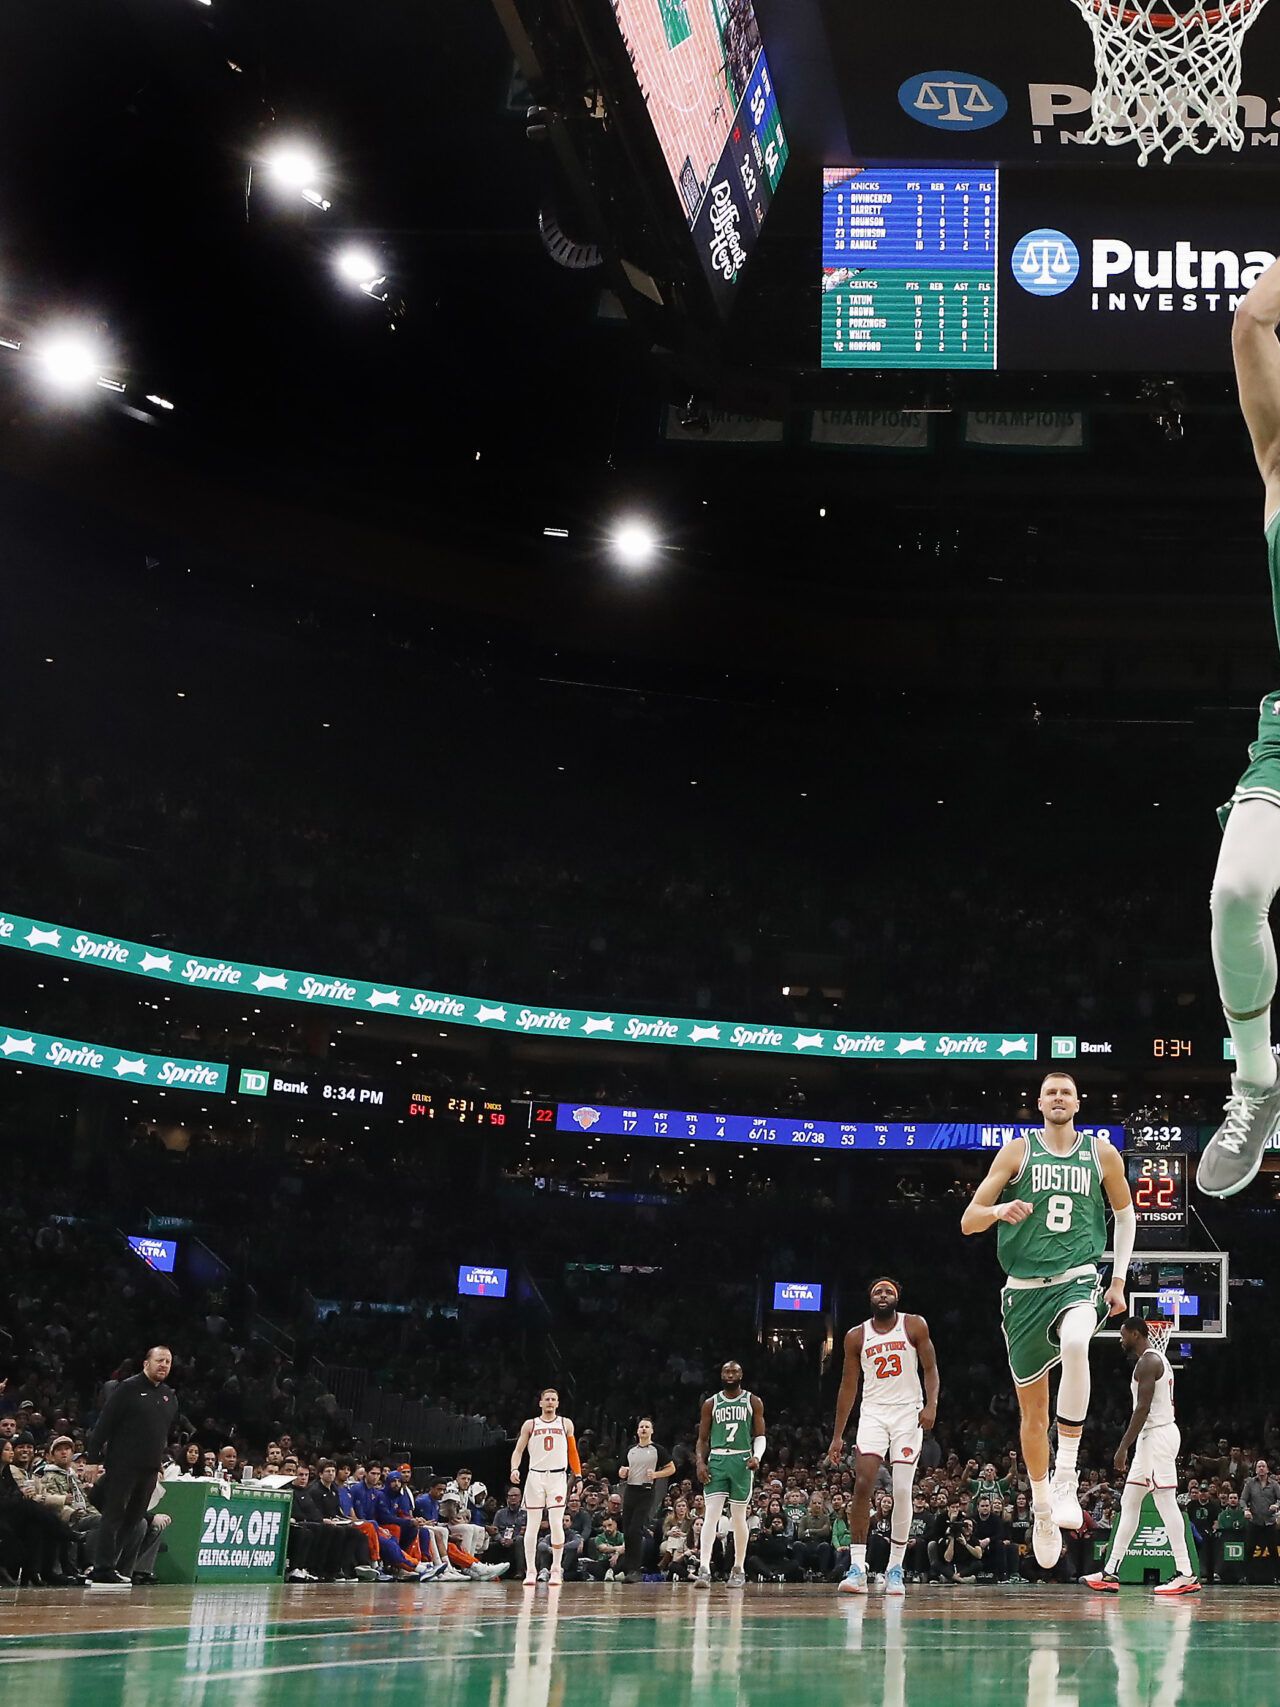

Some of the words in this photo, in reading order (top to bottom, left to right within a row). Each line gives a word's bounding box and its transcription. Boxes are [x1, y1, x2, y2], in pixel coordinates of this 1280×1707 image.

[849, 295, 872, 304] TATUM
[71, 933, 130, 964] Sprite
[181, 958, 242, 987] Sprite
[298, 976, 357, 1002] Sprite
[410, 993, 466, 1018] Sprite
[516, 1008, 571, 1033] Sprite
[623, 1017, 679, 1041] Sprite
[730, 1026, 782, 1048] Sprite
[833, 1034, 886, 1054] Sprite
[935, 1035, 988, 1056] Sprite
[45, 1040, 104, 1070] Sprite
[1080, 1042, 1112, 1054] Bank
[1154, 1039, 1192, 1056] 8:34
[156, 1060, 219, 1086] Sprite
[273, 1078, 308, 1095] Bank
[322, 1084, 356, 1102] 8:34
[360, 1089, 384, 1105] PM
[412, 1094, 432, 1102] CELTICS
[448, 1098, 474, 1111] 2:31
[410, 1104, 425, 1115] 64
[491, 1114, 505, 1125] 58
[536, 1110, 553, 1121] 22
[753, 1119, 767, 1127] 3PT
[623, 1120, 637, 1131] 17
[654, 1122, 668, 1134] 12
[688, 1124, 696, 1136] 3
[716, 1126, 725, 1137] 4
[749, 1129, 776, 1141] 6/15
[792, 1131, 824, 1144] 20/38
[841, 1134, 854, 1145] 53
[878, 1135, 886, 1146] 5
[906, 1135, 914, 1146] 5
[981, 1128, 1015, 1146] NEW
[1142, 1127, 1182, 1141] 2:32
[1156, 1142, 1171, 1150] 2nd
[1142, 1159, 1179, 1176] 2:31
[1032, 1164, 1091, 1197] BOSTON
[1136, 1177, 1174, 1206] 22
[1046, 1195, 1073, 1232] 8
[1143, 1212, 1183, 1221] TISSOT
[466, 1274, 498, 1284] ULTRA
[782, 1290, 814, 1299] ULTRA
[865, 1344, 883, 1358] NEW
[885, 1341, 906, 1352] YORK
[874, 1354, 902, 1379] 23
[715, 1406, 748, 1424] BOSTON
[725, 1423, 738, 1442] 7
[544, 1436, 554, 1452] 0
[200, 1507, 244, 1544] 20%
[248, 1510, 282, 1546] OFF
[198, 1548, 276, 1568] CELTICS.COM/SHOP
[1144, 1548, 1174, 1556] balanc
